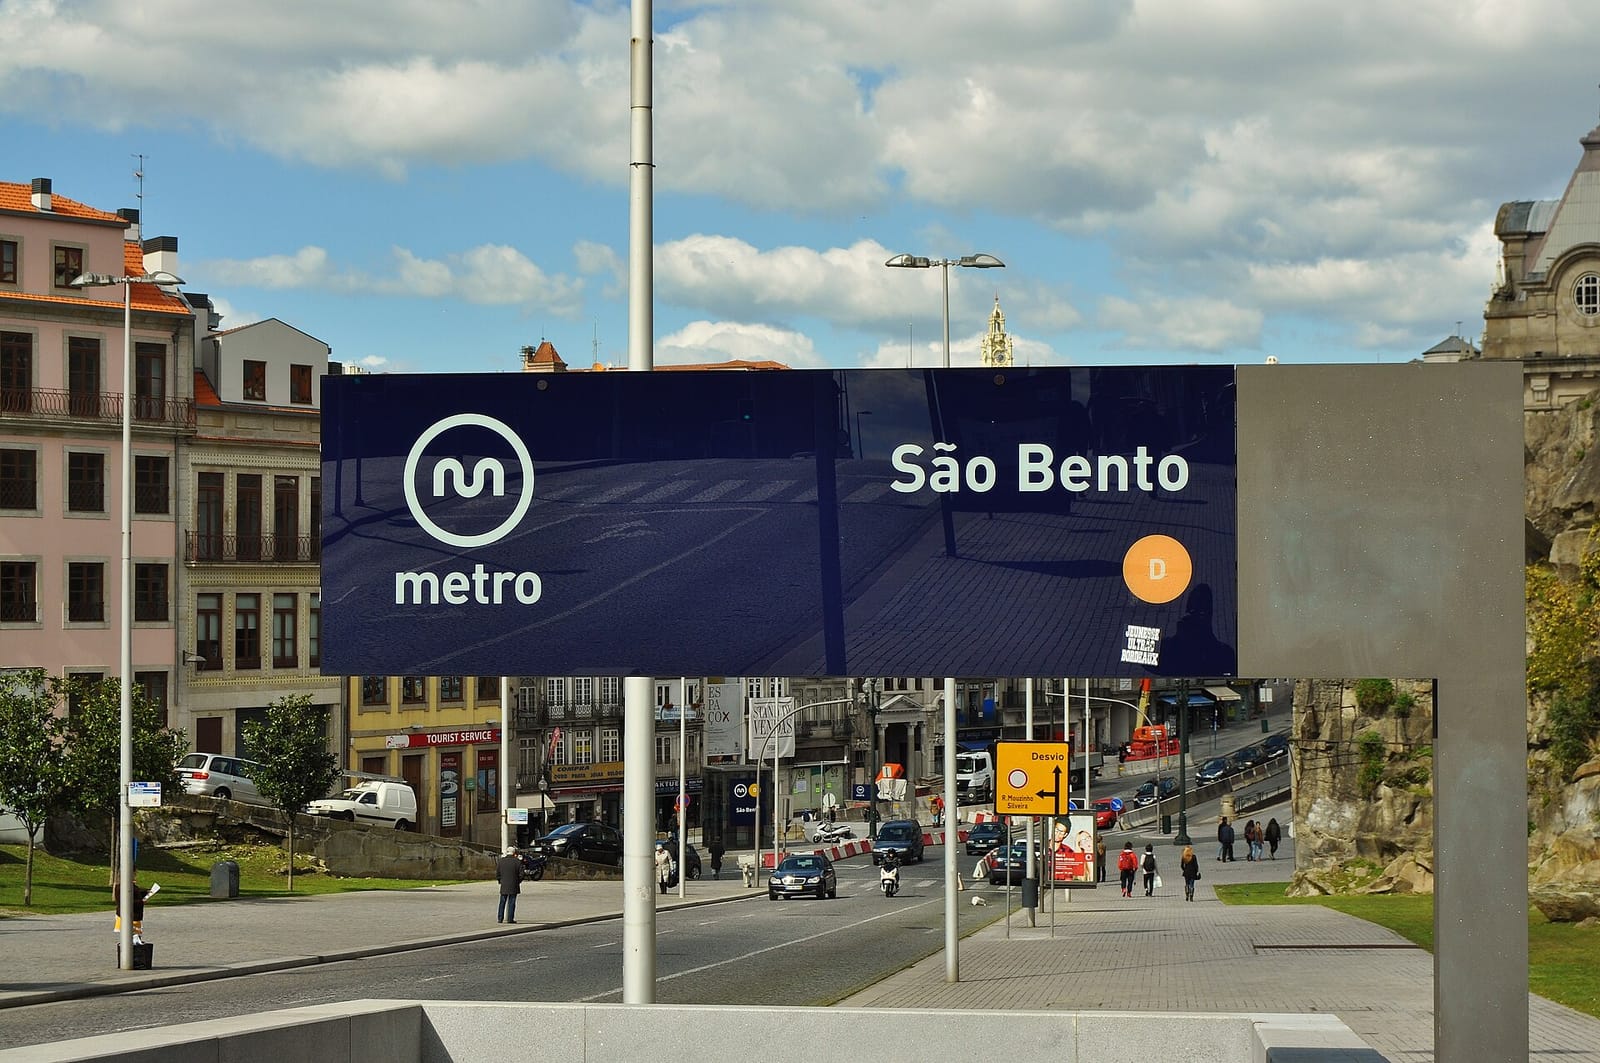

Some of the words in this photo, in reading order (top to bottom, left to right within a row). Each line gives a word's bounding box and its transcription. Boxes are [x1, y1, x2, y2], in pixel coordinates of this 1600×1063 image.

[890, 442, 996, 493] São
[1018, 443, 1189, 492] Bento
[1149, 558, 1166, 580] D
[395, 564, 542, 605] metro
[1120, 649, 1159, 667] BORDEAUX
[708, 686, 721, 699] ES
[708, 700, 720, 711] PA
[426, 733, 459, 744] TOURIST
[460, 730, 492, 742] SERVICE
[1031, 752, 1065, 761] Desvio
[557, 765, 590, 773] COMPRA
